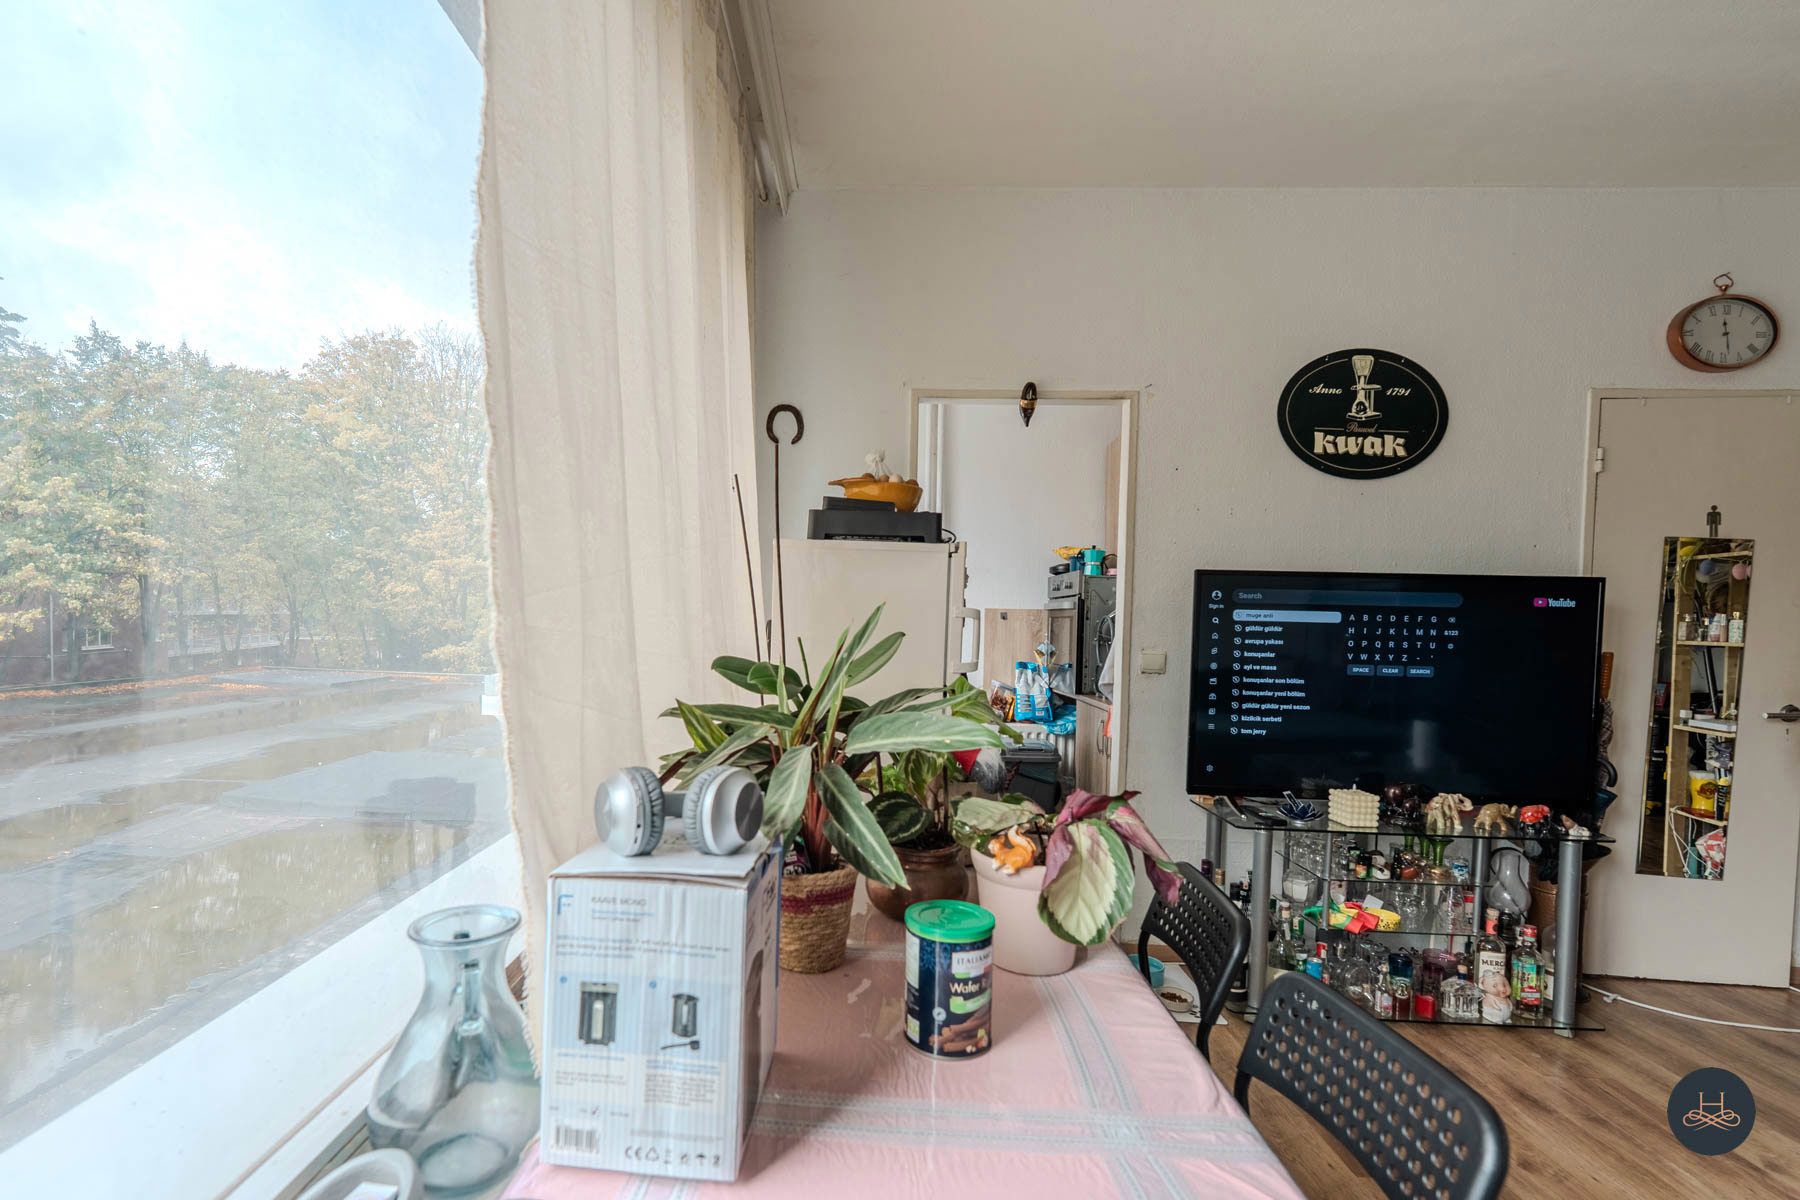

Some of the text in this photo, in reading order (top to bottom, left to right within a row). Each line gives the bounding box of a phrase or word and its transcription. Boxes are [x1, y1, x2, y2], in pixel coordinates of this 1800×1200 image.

[1309, 384, 1342, 394] Anno
[1548, 598, 1576, 607] YouTube
[949, 981, 980, 994] Wafer
